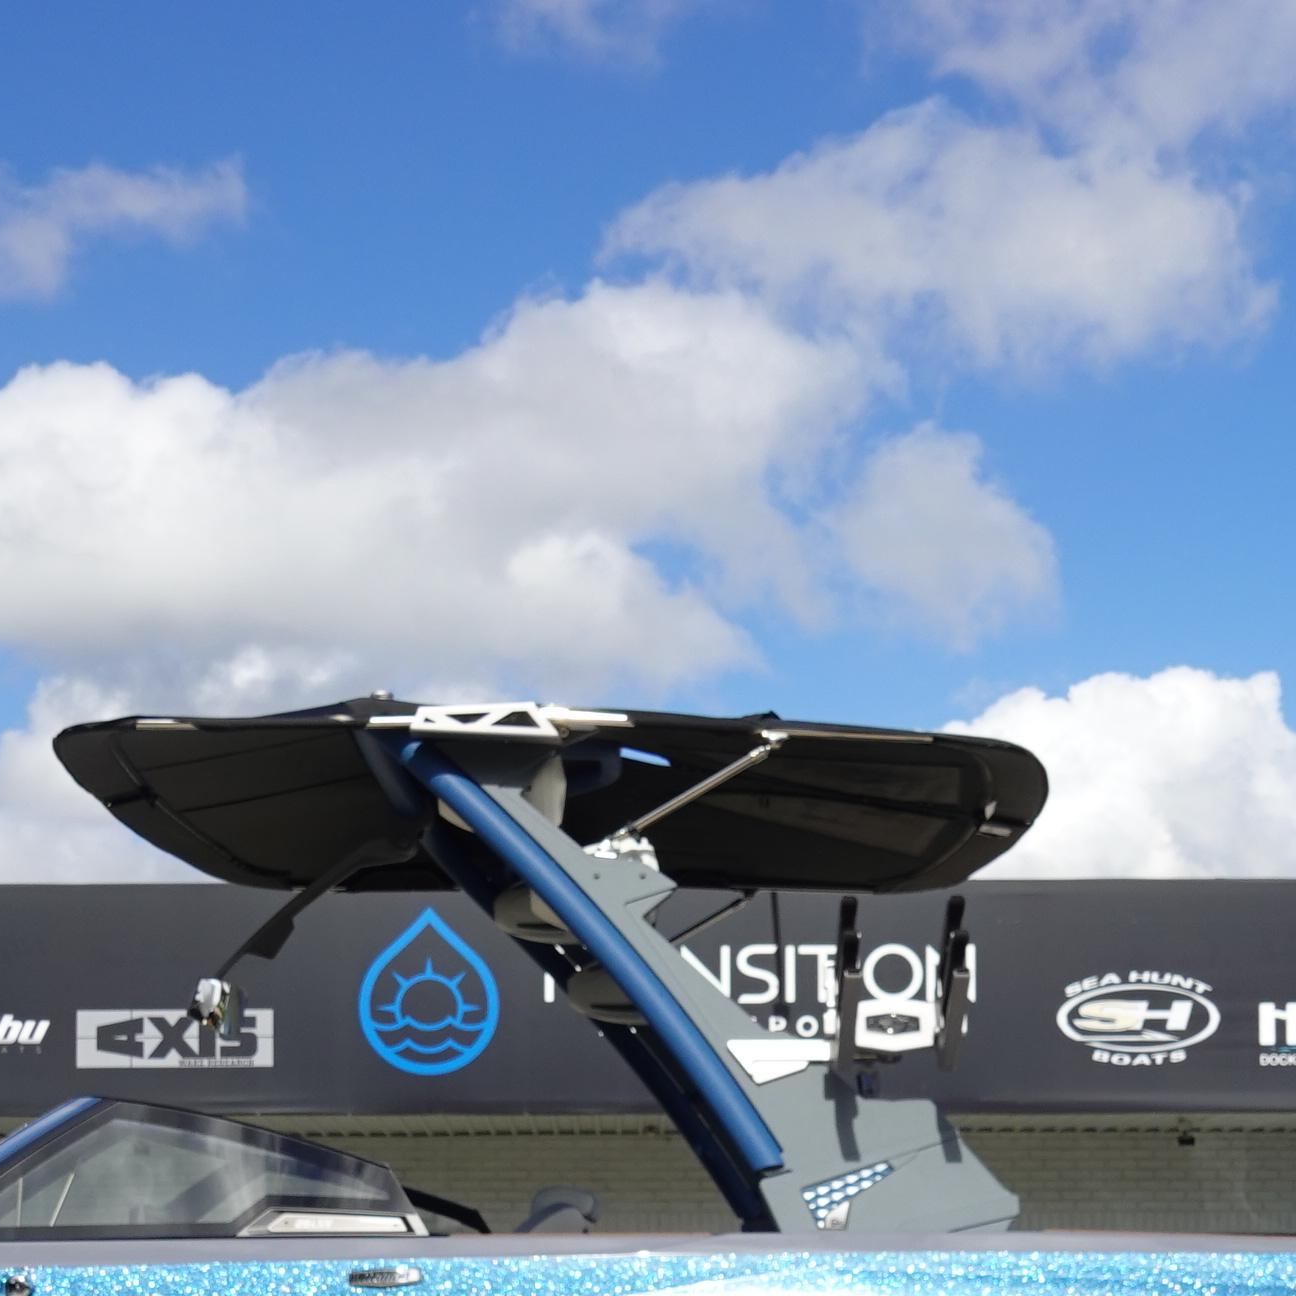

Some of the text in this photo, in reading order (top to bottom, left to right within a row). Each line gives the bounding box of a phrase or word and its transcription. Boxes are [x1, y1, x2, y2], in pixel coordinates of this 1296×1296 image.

[1064, 970, 1213, 998] SEA HUNT
[97, 1016, 258, 1060] AXIS
[1091, 1049, 1188, 1066] BOATS
